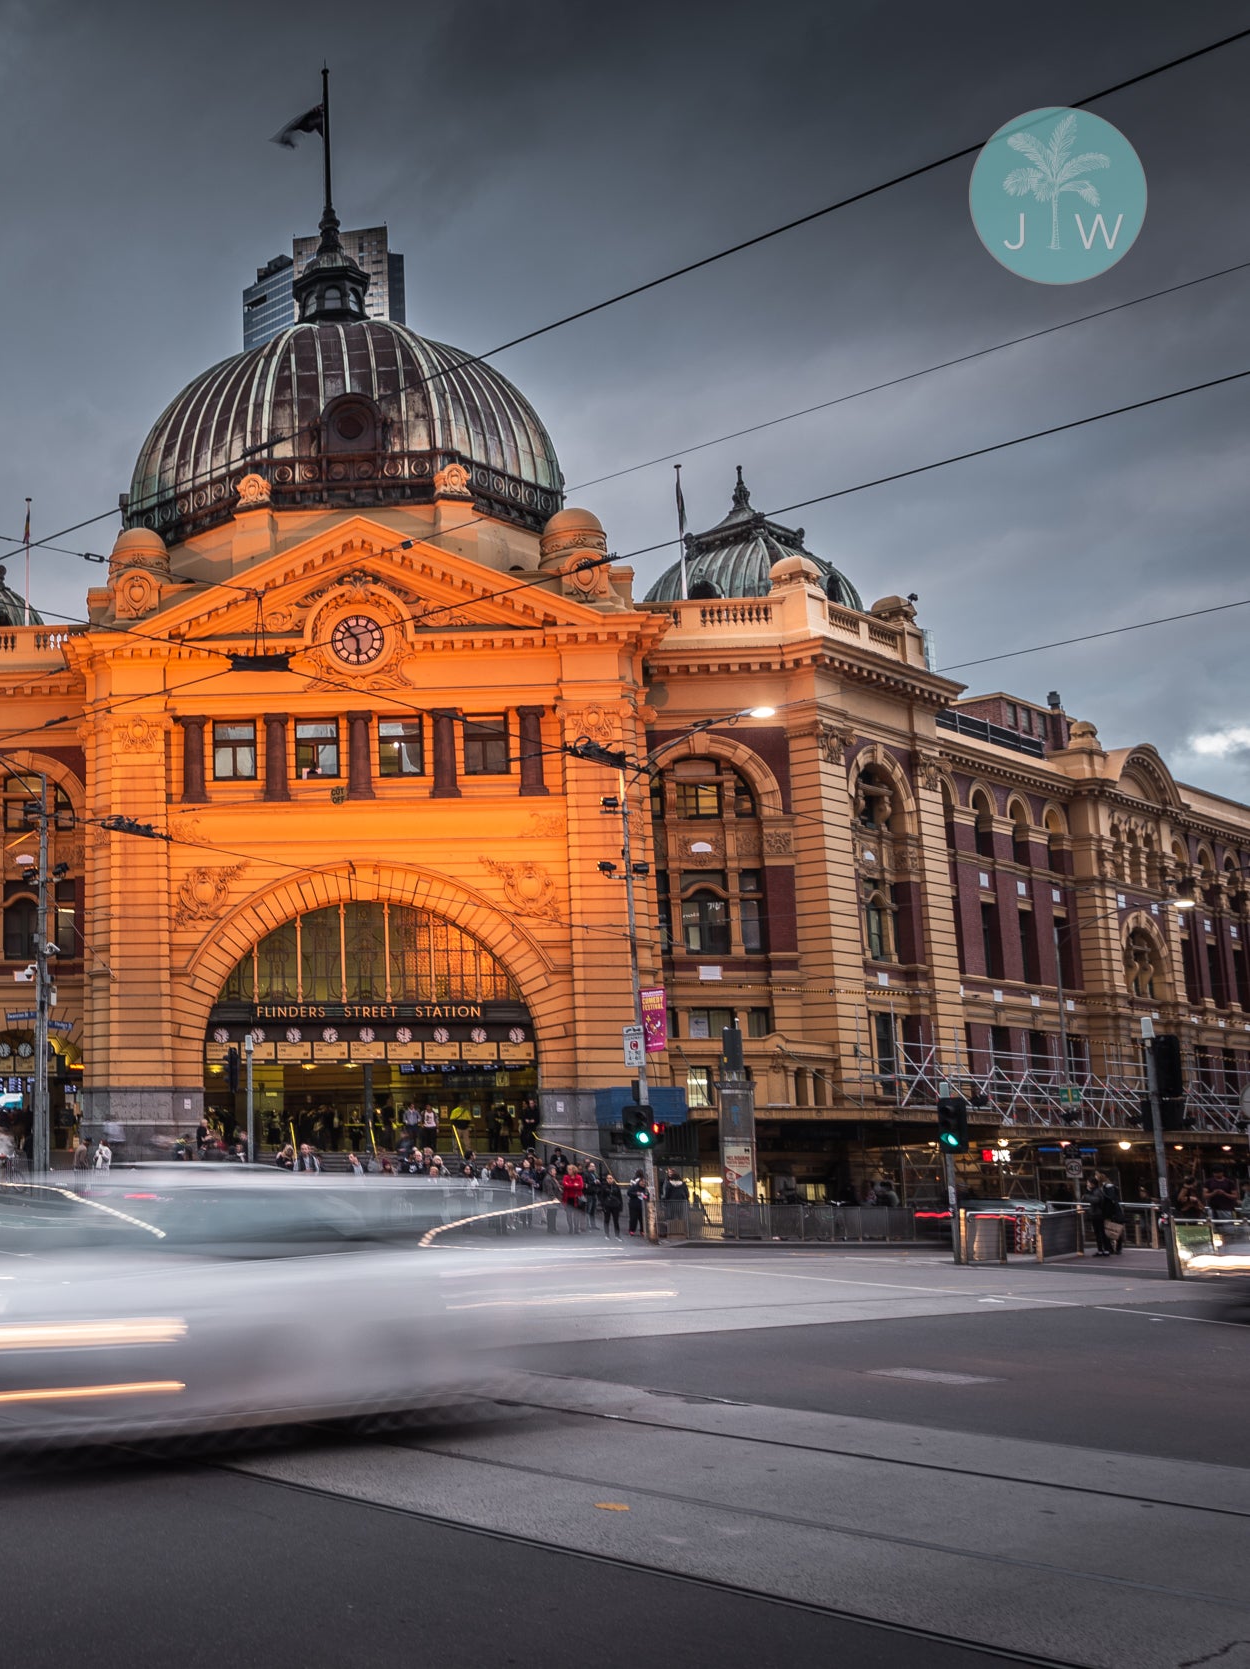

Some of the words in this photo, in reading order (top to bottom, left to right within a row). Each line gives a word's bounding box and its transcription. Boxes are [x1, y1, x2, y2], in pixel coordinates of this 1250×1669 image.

[642, 996, 663, 1004] COMEDY
[642, 1003, 664, 1011] FESTIVAL
[256, 1006, 326, 1018] FLINDERS
[344, 1006, 398, 1018] STREET
[415, 1006, 482, 1018] STATION
